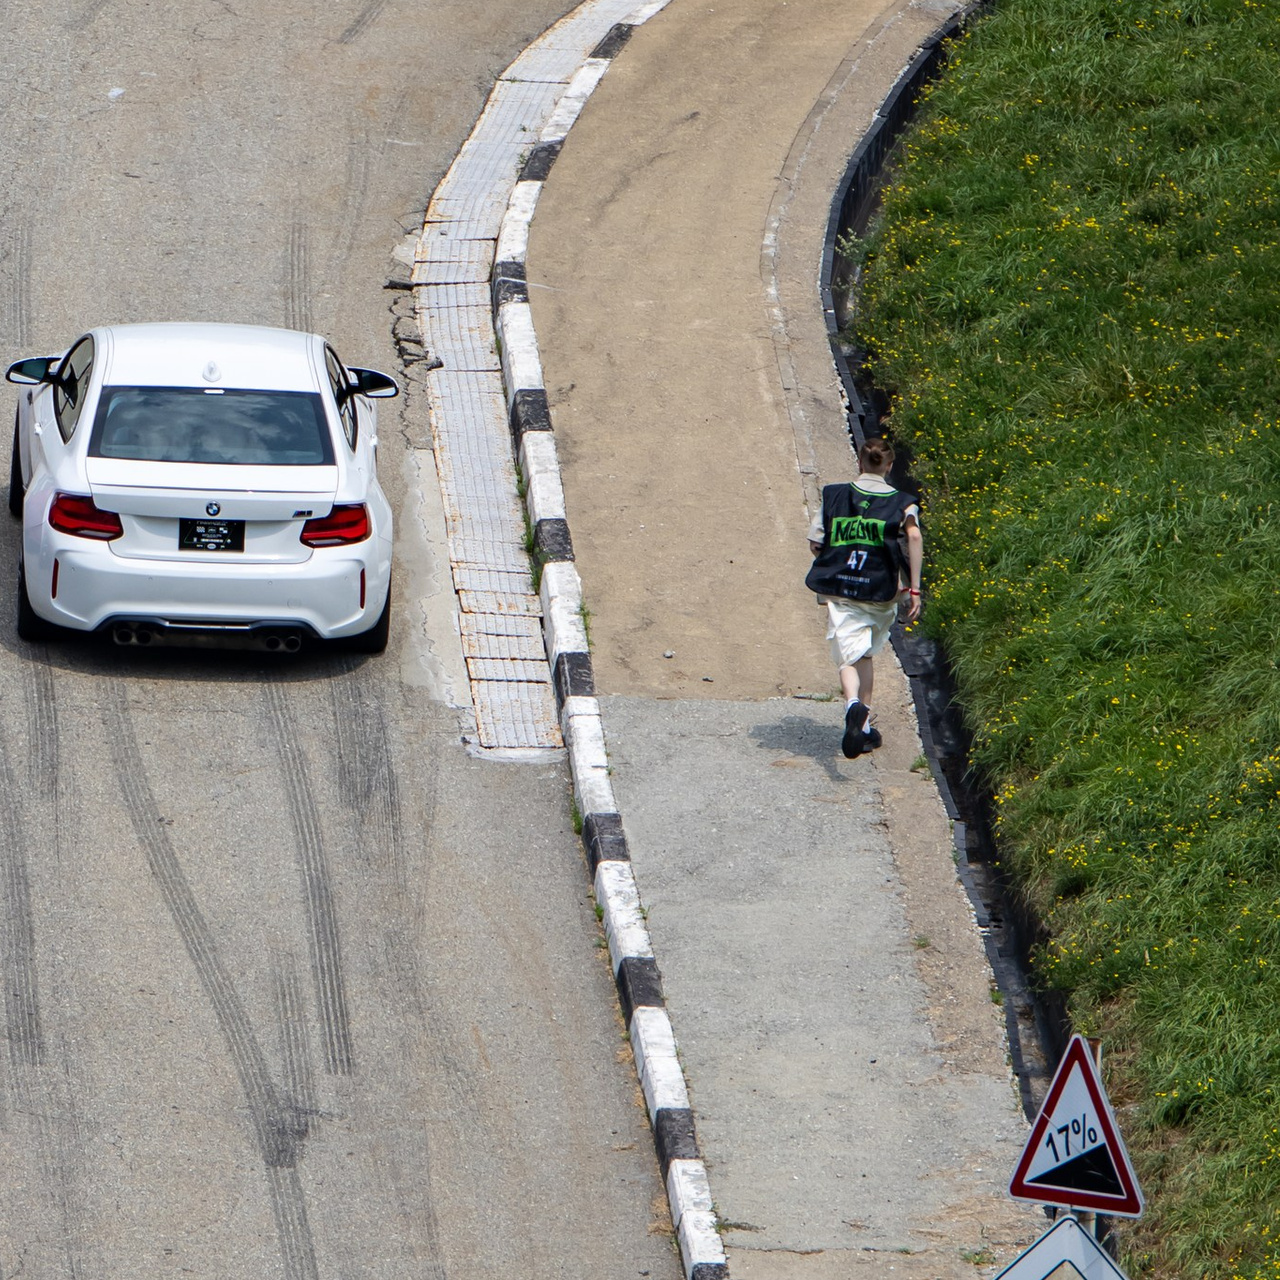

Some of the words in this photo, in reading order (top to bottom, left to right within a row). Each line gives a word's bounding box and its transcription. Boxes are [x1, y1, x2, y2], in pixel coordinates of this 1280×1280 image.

[834, 519, 882, 542] MEDIA
[847, 550, 868, 571] 47
[1045, 1113, 1099, 1165] 17%
